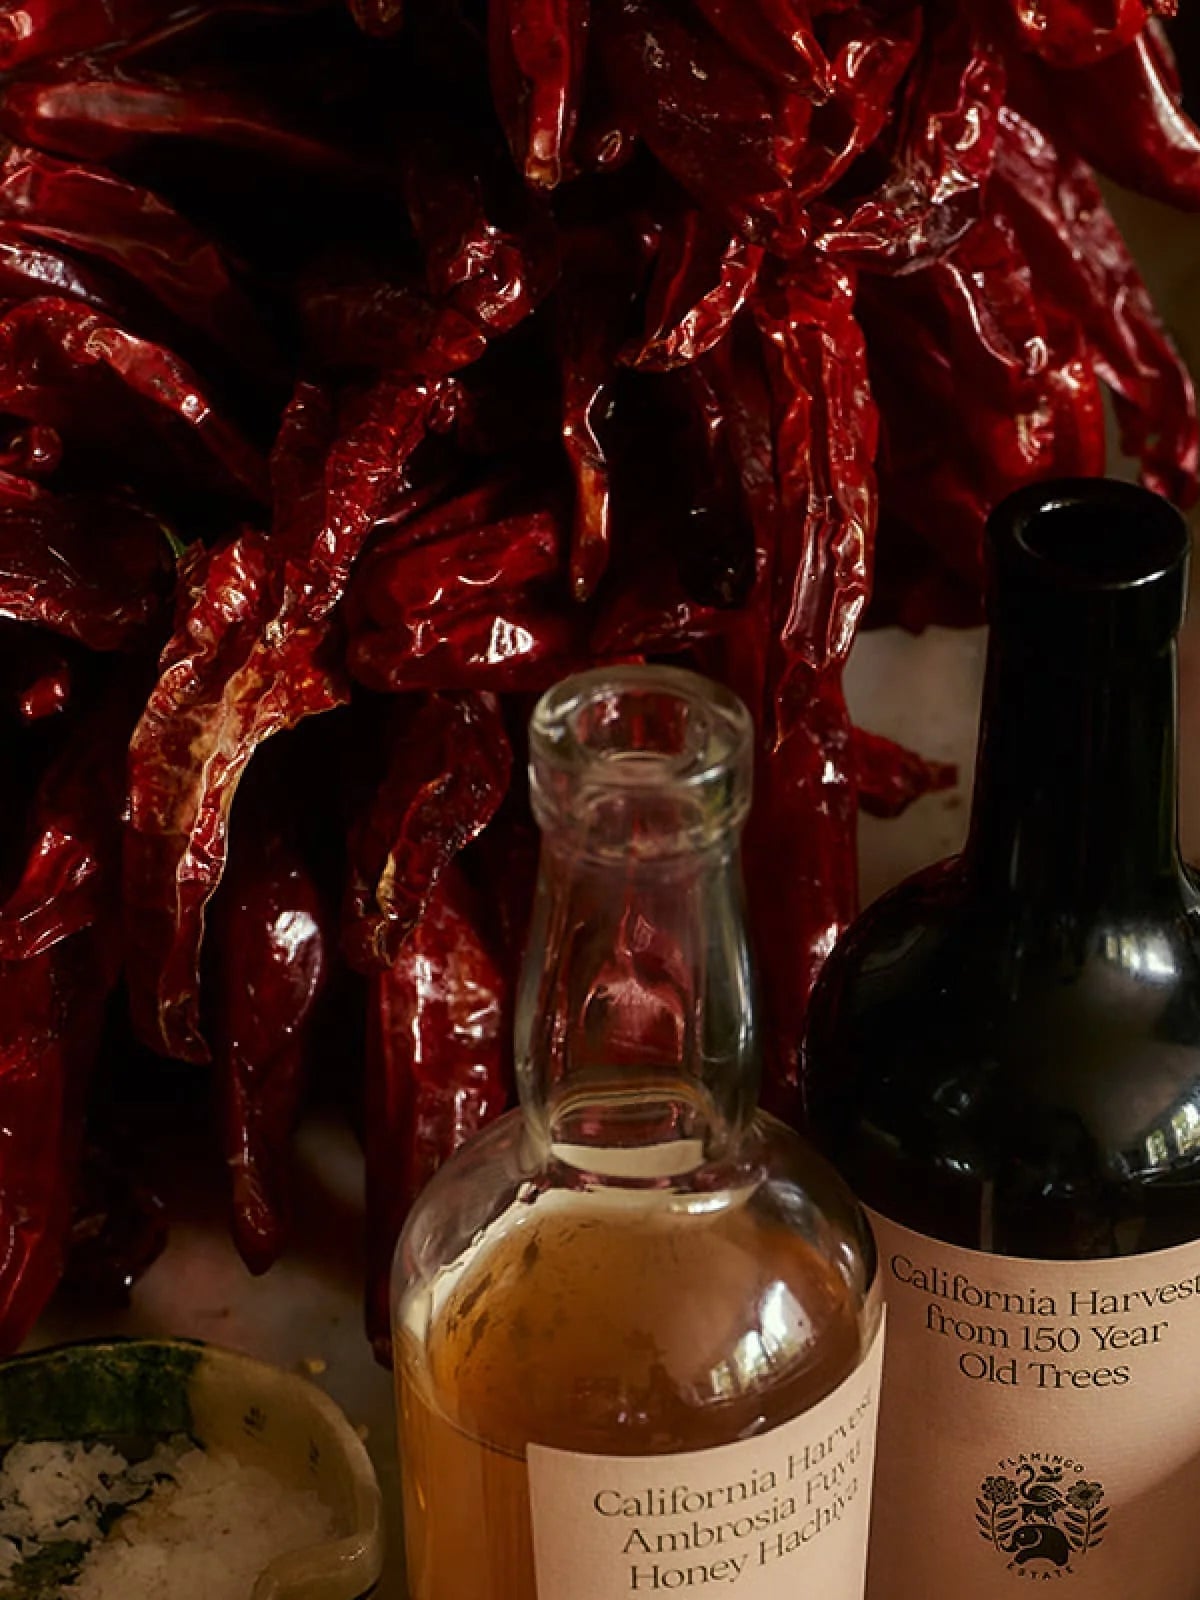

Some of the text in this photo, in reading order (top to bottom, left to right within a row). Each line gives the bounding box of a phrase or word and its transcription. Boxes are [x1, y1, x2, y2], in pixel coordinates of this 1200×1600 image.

[891, 1254, 1056, 1317] California
[926, 1304, 1169, 1352] from 150 Year
[959, 1351, 1130, 1389] Old Trees
[593, 1385, 872, 1518] California Harvest
[622, 1496, 796, 1554] Ambrosia
[630, 1552, 748, 1590] Honey
